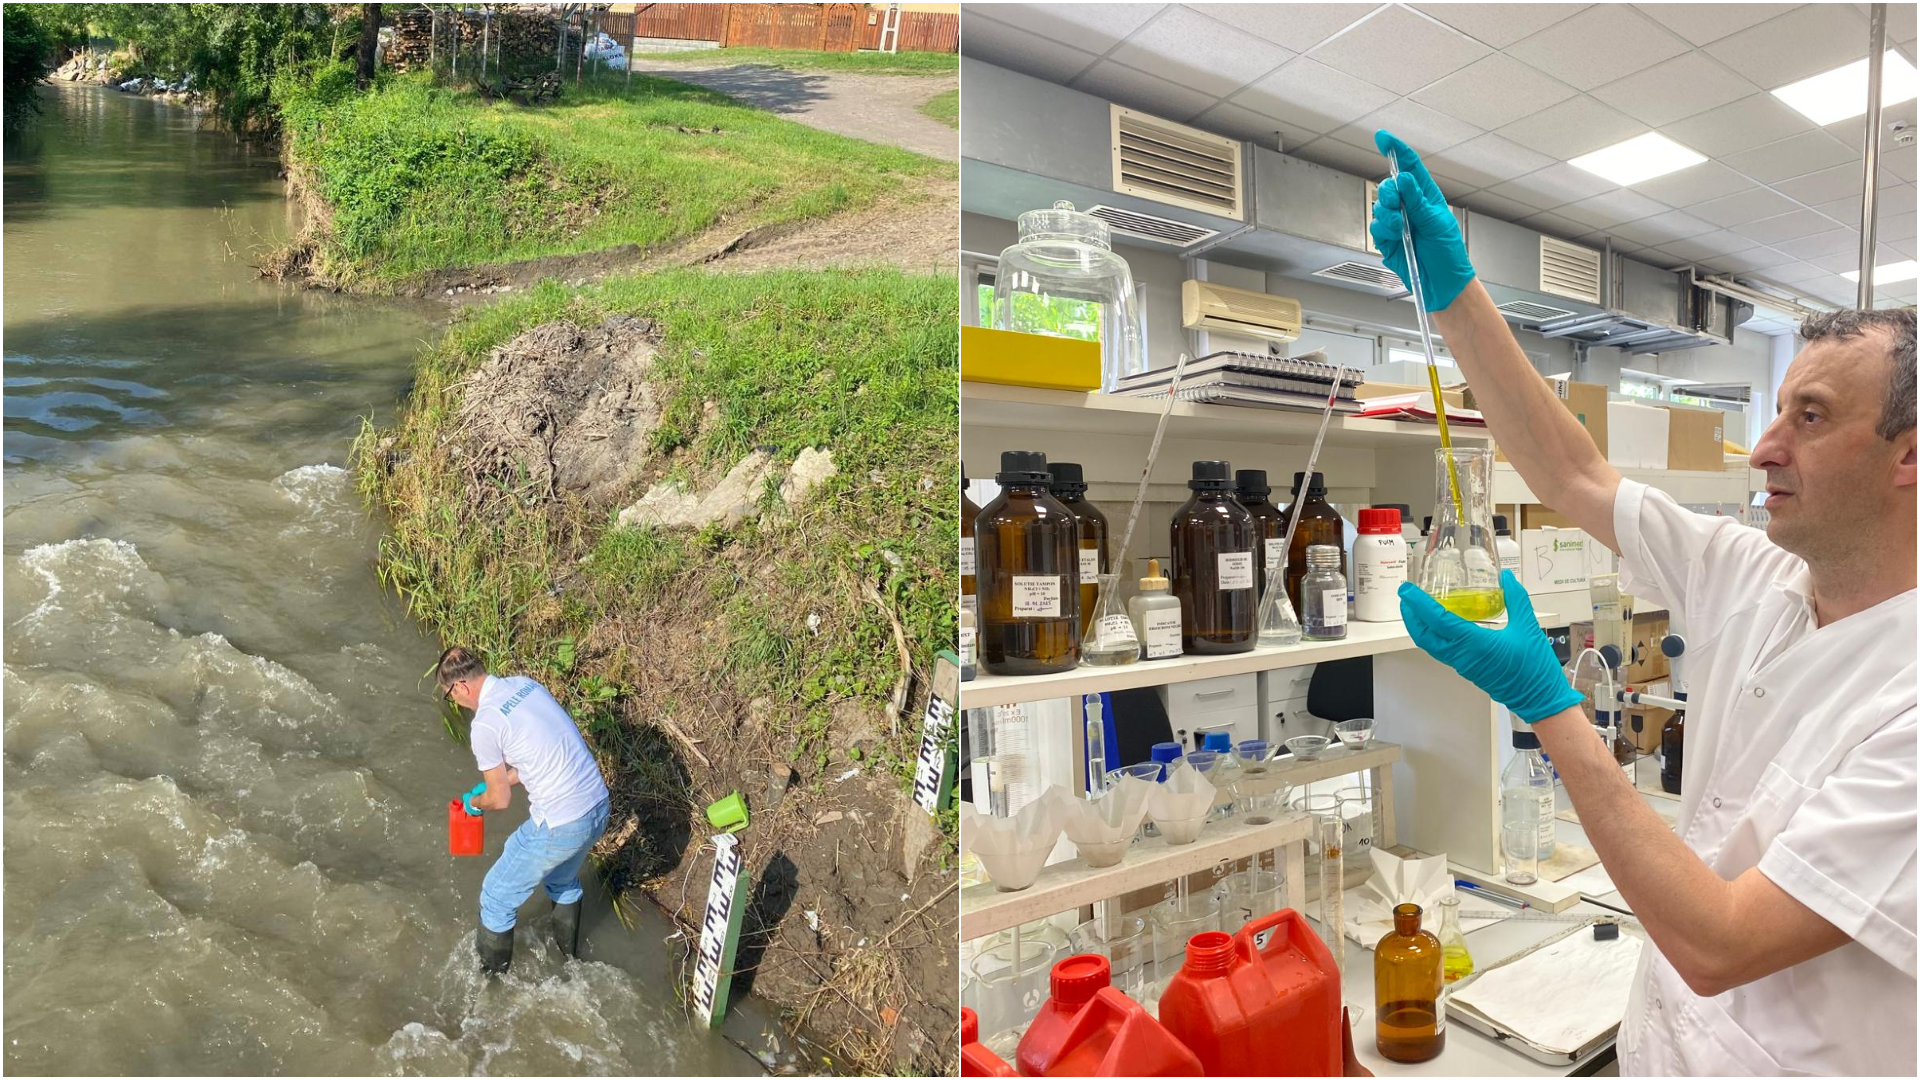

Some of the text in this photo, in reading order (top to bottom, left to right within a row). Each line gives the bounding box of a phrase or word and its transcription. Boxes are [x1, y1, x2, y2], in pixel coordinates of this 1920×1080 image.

[500, 696, 521, 716] APELE
[1358, 837, 1370, 846] 10
[1256, 932, 1265, 946] 5
